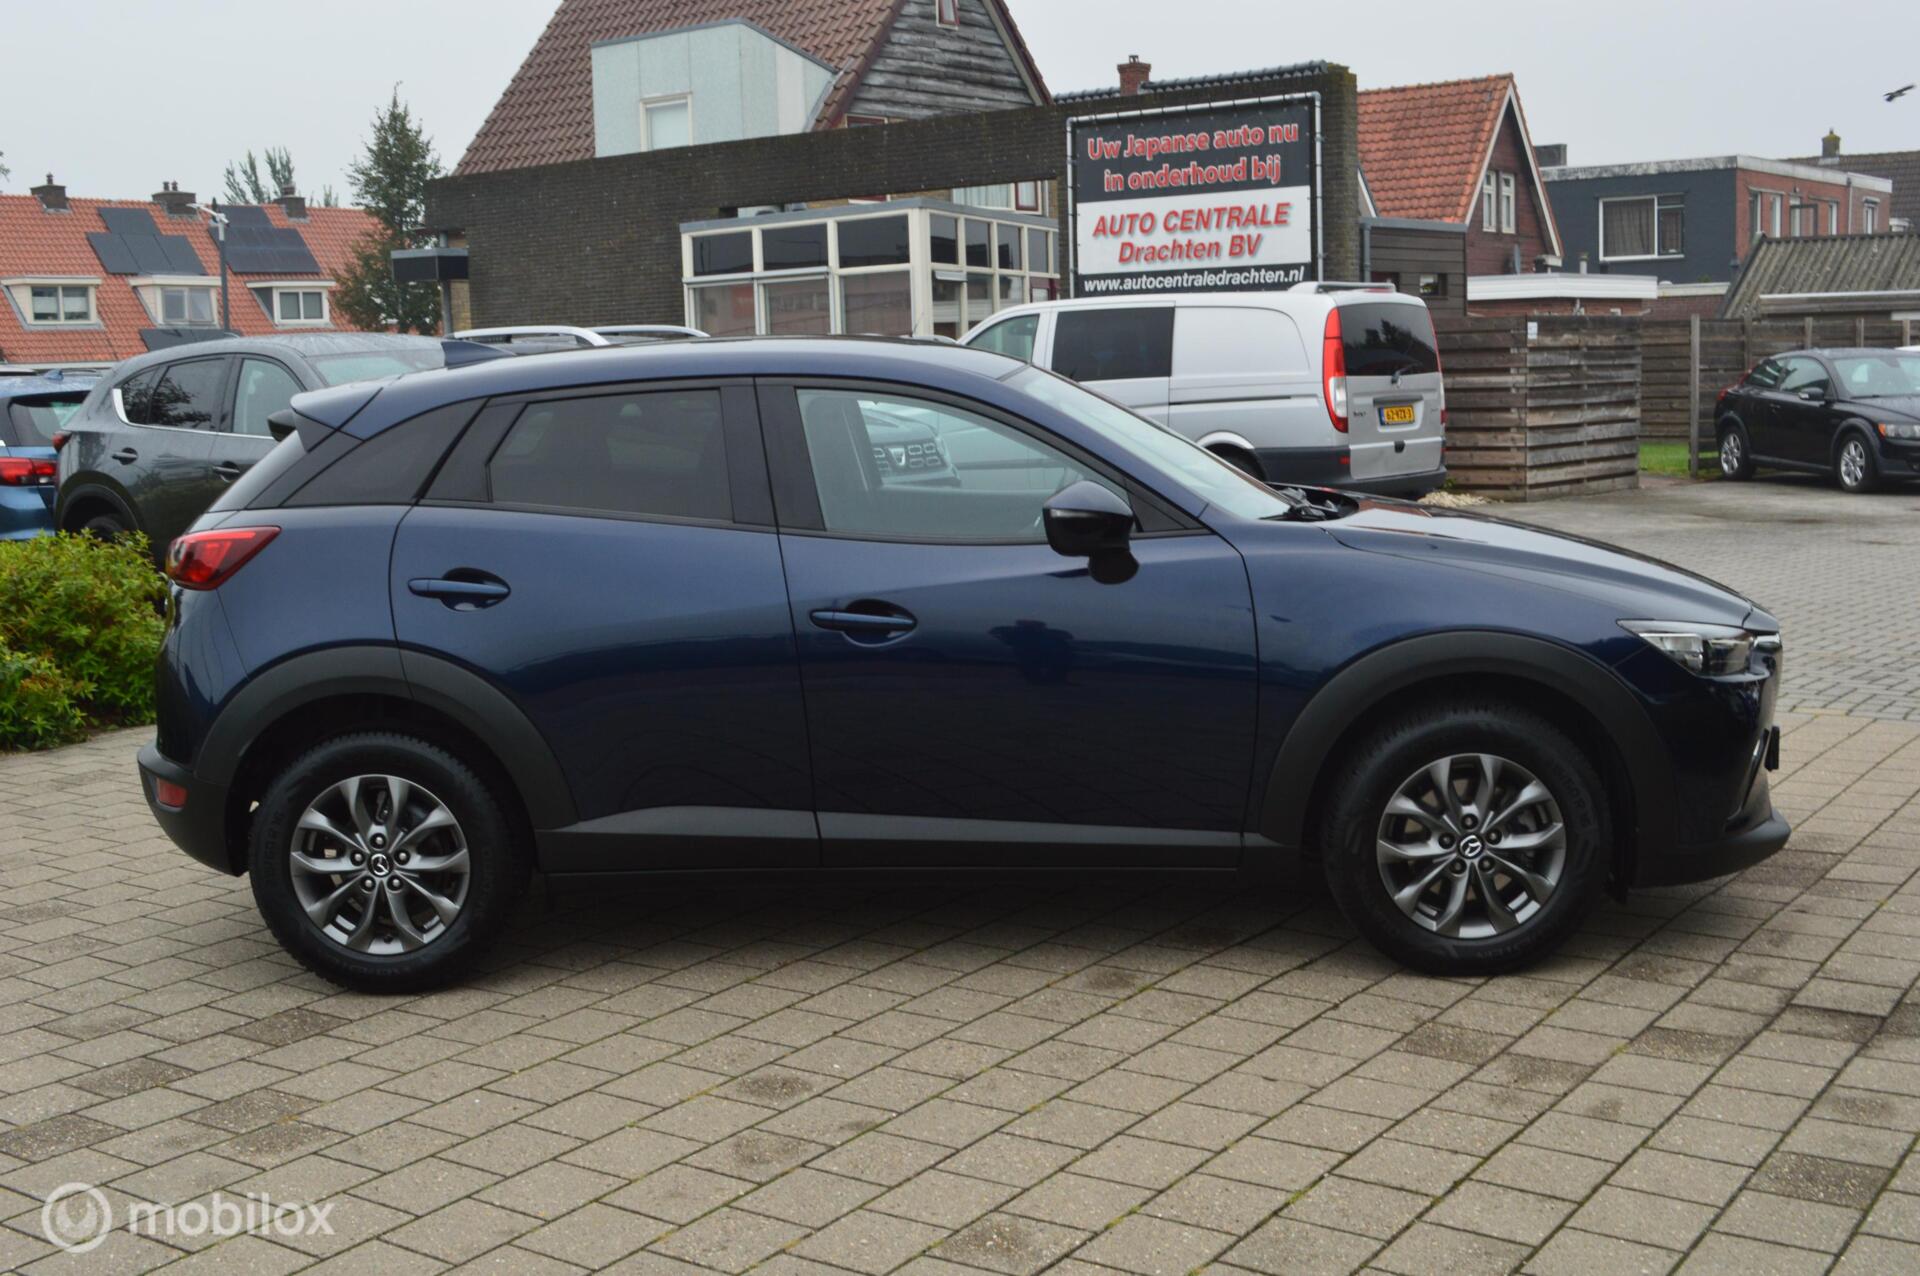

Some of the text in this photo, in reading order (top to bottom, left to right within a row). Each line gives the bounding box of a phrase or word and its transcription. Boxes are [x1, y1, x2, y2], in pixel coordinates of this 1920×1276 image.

[1088, 123, 1299, 160] Uw Japanse auto nu
[1104, 154, 1281, 192] in onderhoud bij
[1092, 202, 1291, 237] AUTO CENTRALE
[1118, 233, 1262, 263] Drachten BV
[1084, 266, 1305, 291] www.autocentraledrachten.nl
